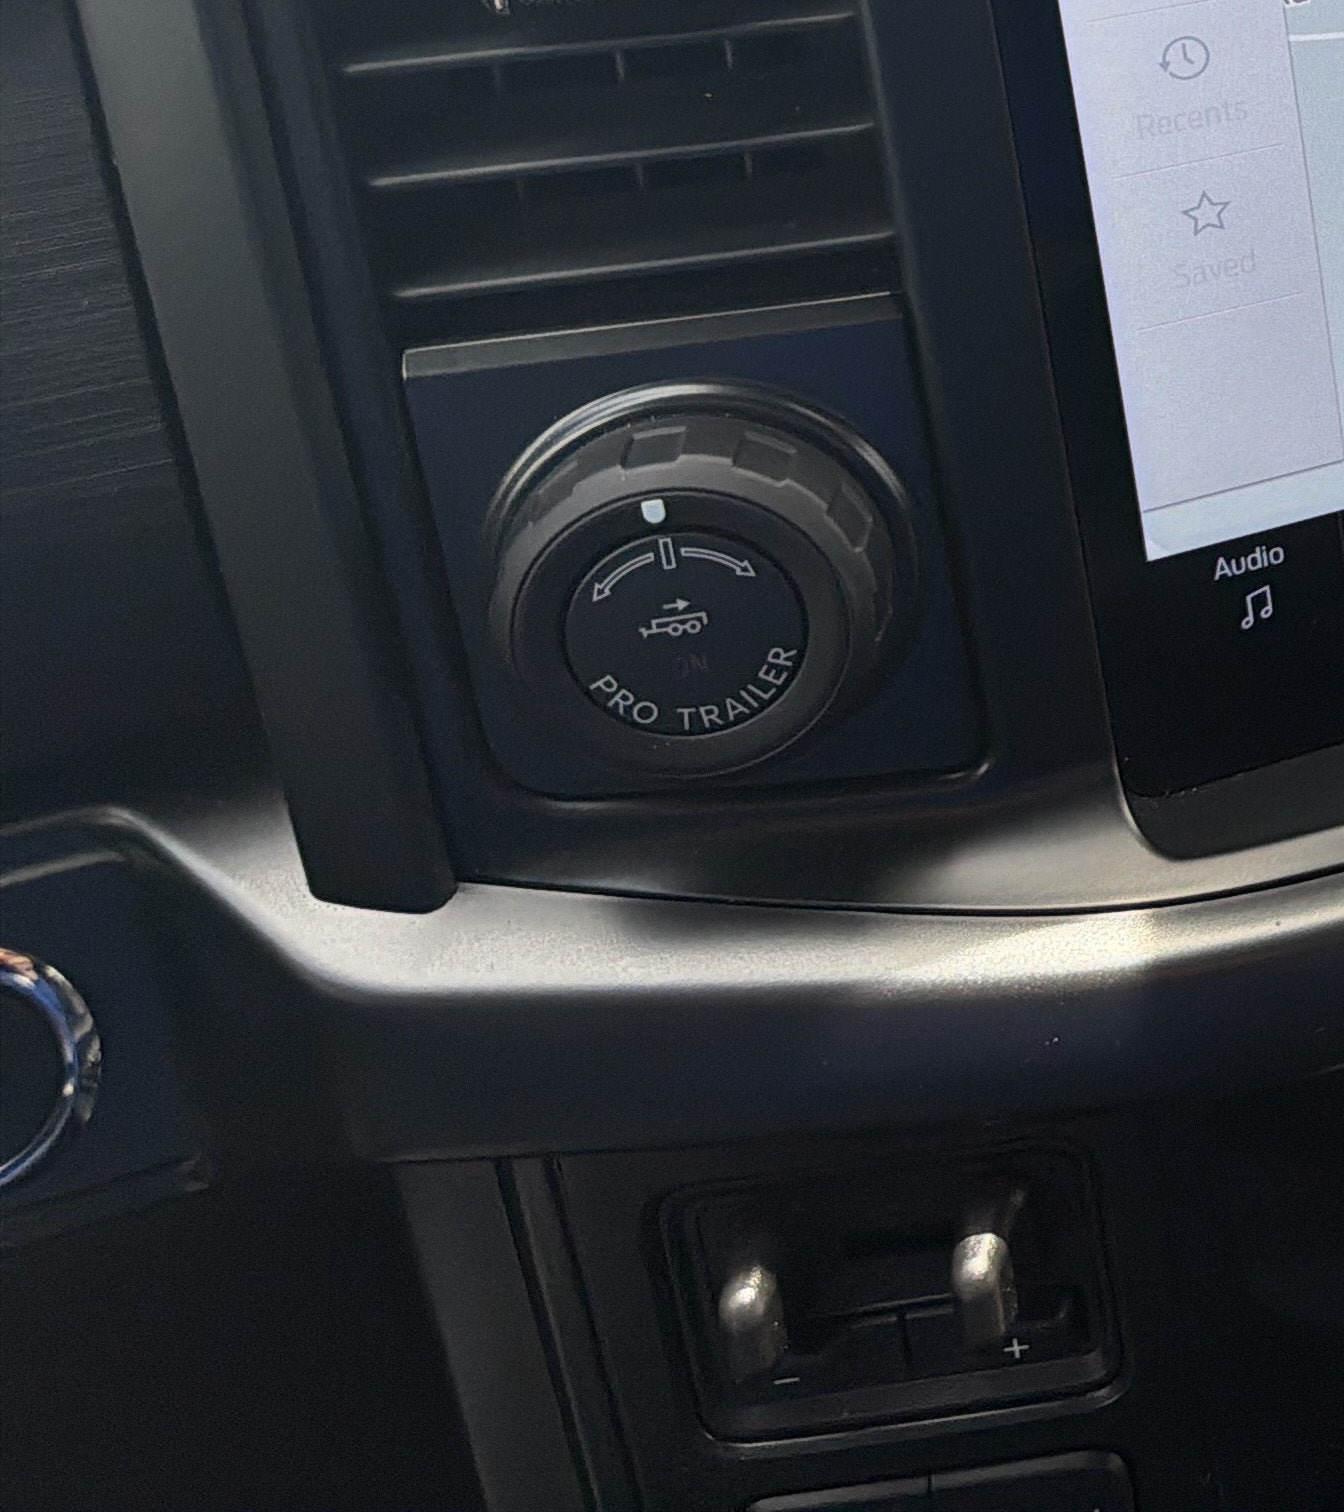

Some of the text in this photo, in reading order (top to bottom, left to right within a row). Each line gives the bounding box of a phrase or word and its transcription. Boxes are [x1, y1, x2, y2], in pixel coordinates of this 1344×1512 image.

[1136, 97, 1248, 139] Recents
[1173, 251, 1256, 287] Saved
[1214, 545, 1284, 581] Audio
[589, 646, 797, 730] PRO TRAILER
